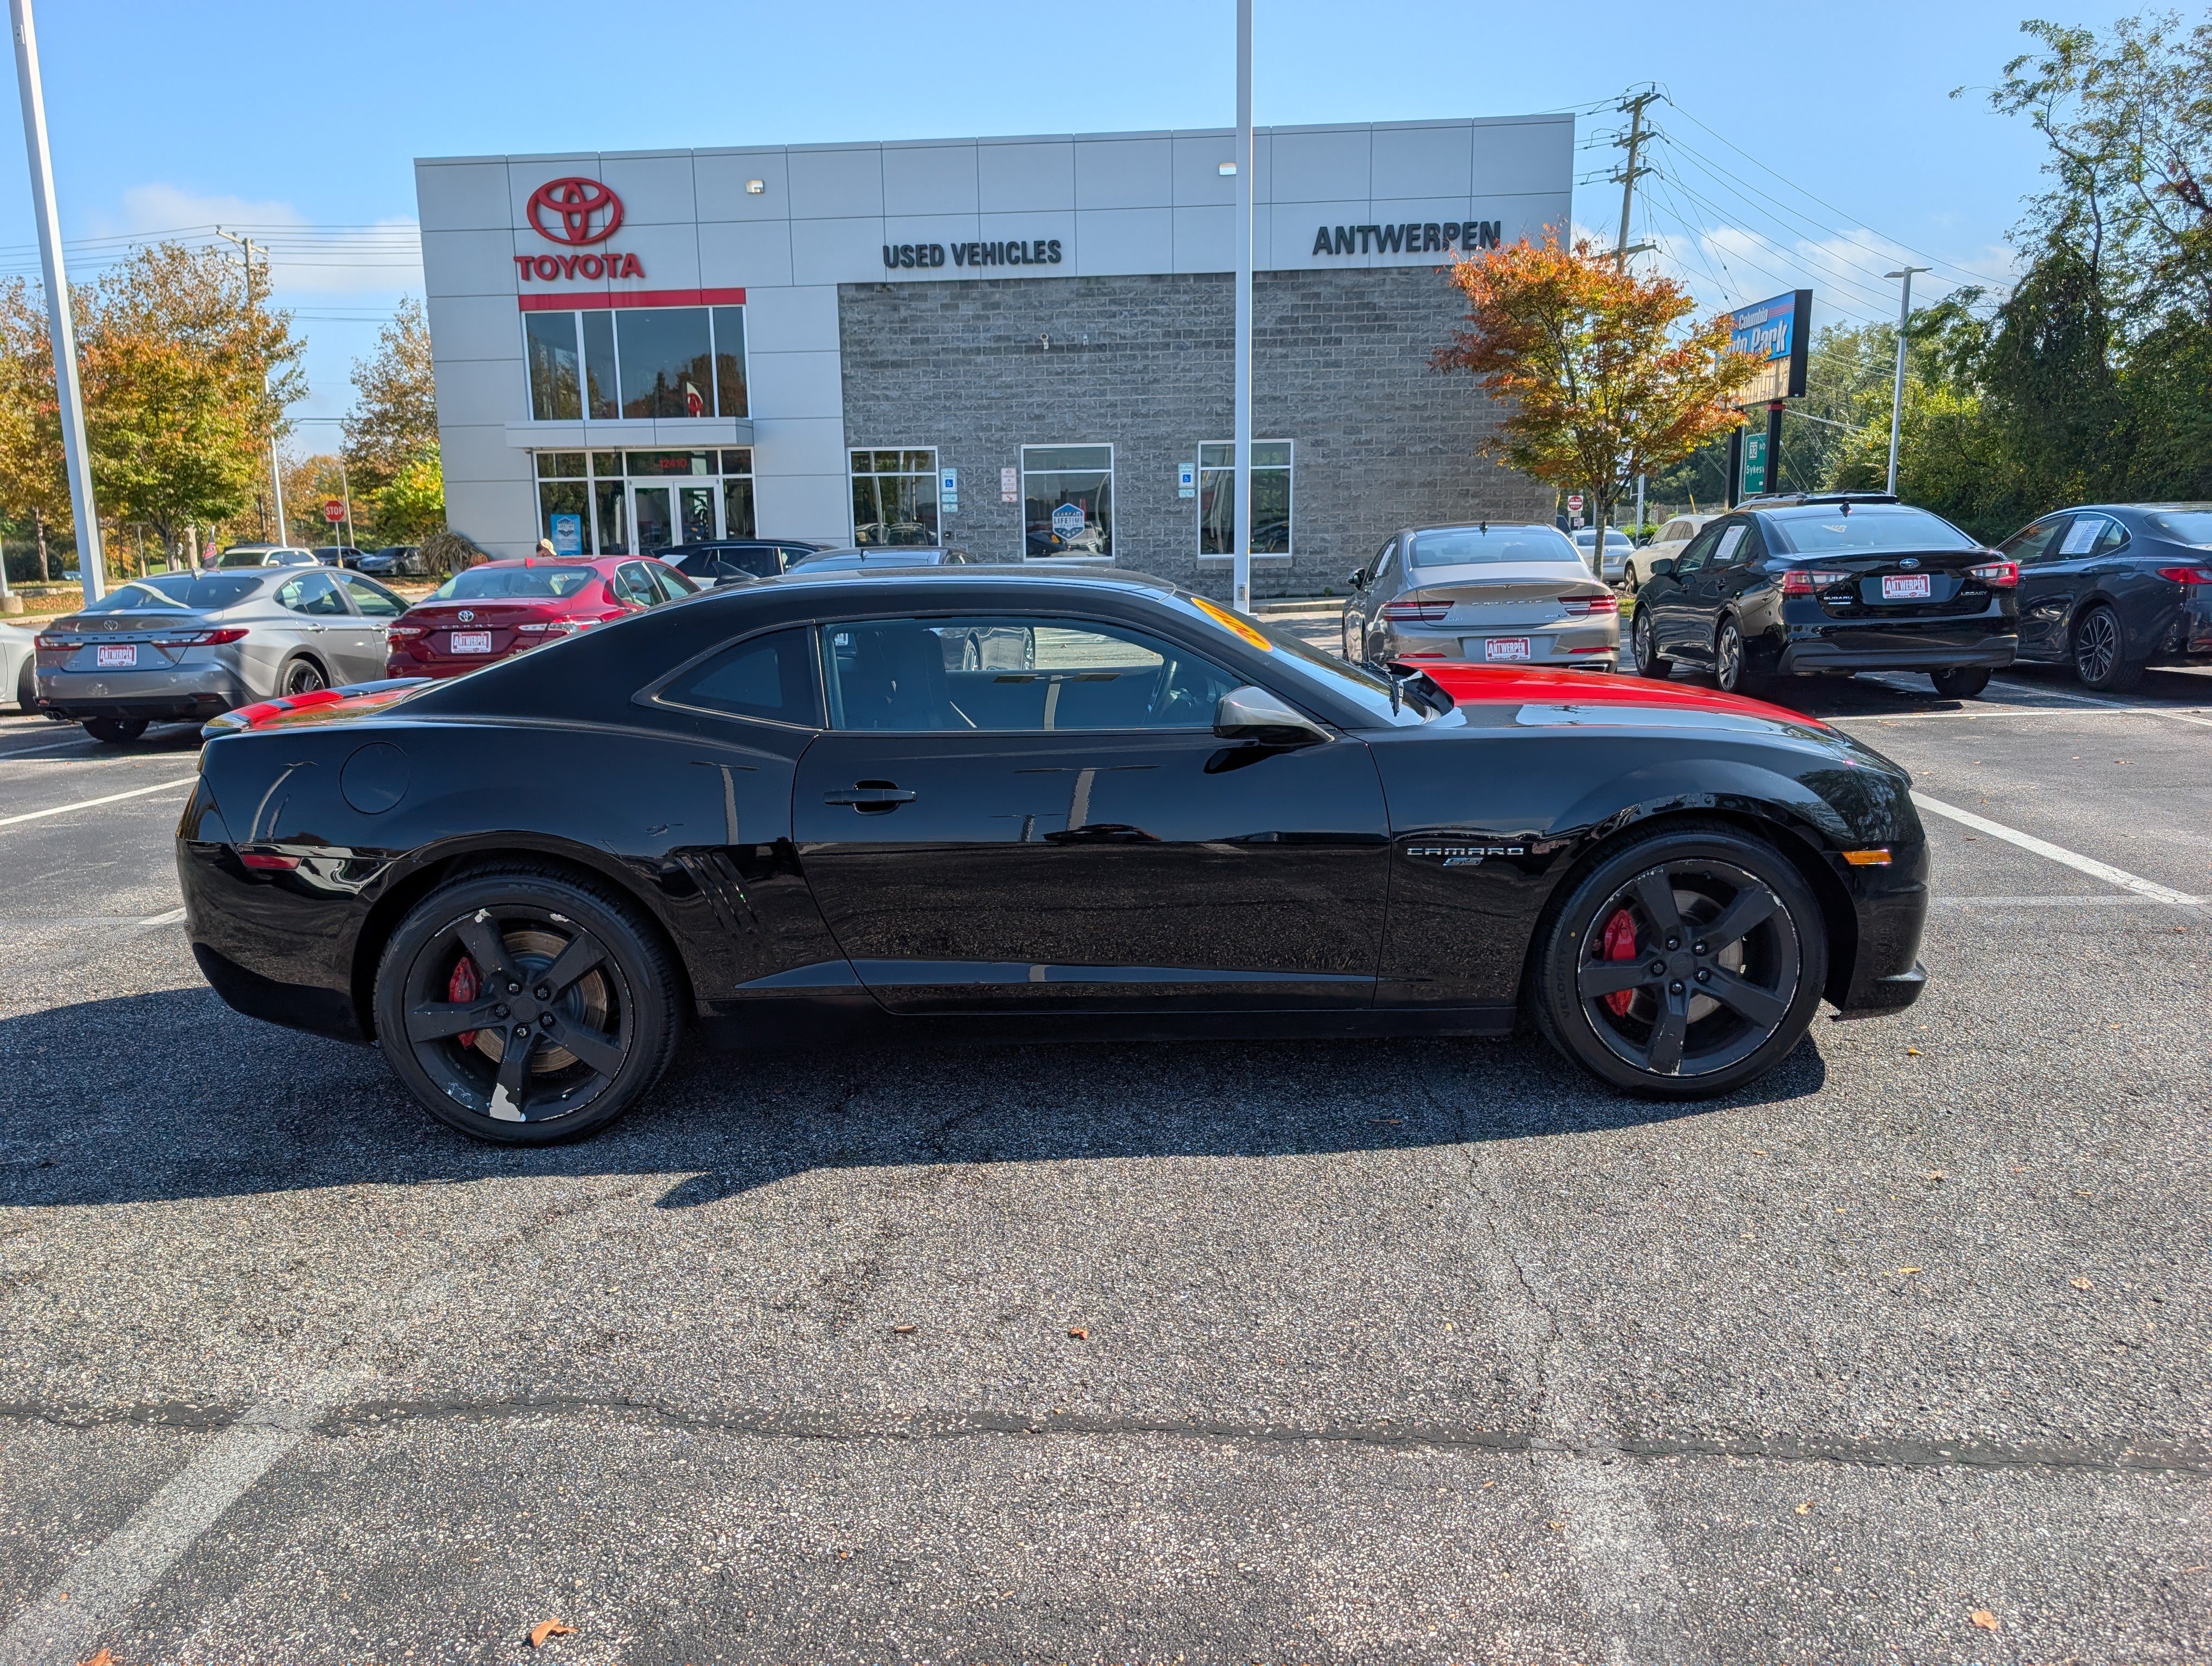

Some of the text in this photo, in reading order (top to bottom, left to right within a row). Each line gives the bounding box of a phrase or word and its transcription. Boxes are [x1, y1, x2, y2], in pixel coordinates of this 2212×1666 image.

[1313, 221, 1501, 255] ANTWERPEN
[883, 239, 1062, 268] USED VEHICLES
[513, 253, 646, 281] TOYOTA
[1739, 306, 1769, 331] Columbia
[1750, 319, 1788, 355] Park
[1750, 446, 1757, 457] 32
[325, 506, 343, 516] STOP
[1886, 579, 1925, 592] ANTWERPEN
[454, 635, 487, 646] ANTWERPEN
[1488, 642, 1525, 654] ANTWERPEN
[100, 649, 133, 660] ANTWERPEN
[1407, 848, 1524, 856] CAMARO
[1442, 857, 1484, 867] SS
